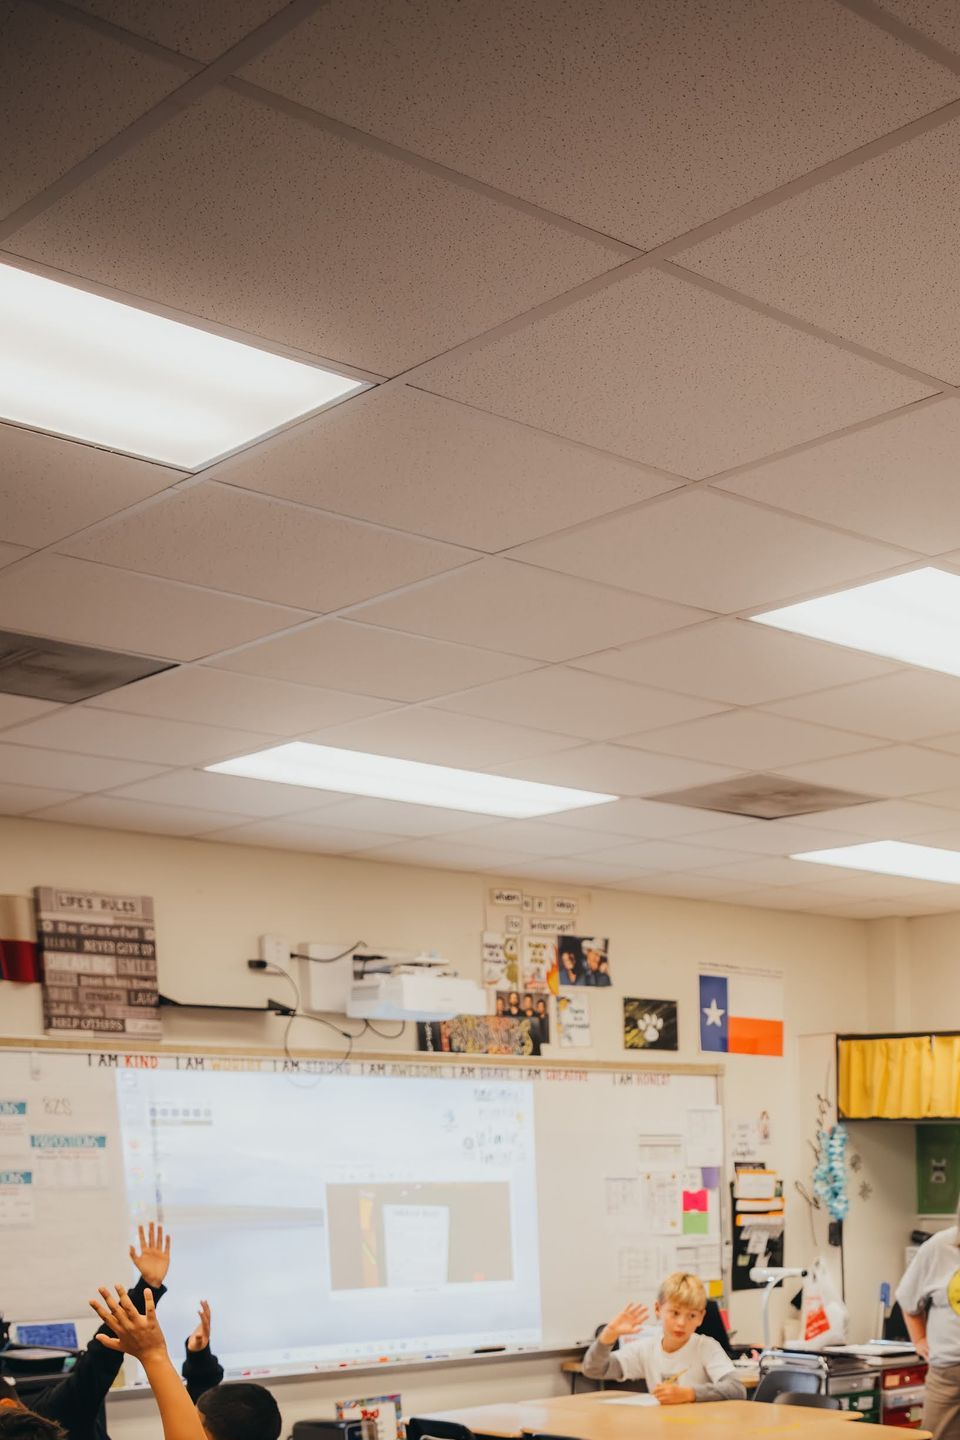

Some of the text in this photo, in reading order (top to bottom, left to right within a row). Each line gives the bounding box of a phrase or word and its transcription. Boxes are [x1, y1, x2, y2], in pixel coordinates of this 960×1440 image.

[60, 896, 136, 912] LIFE'S RULES
[80, 924, 139, 939] Grateful
[83, 940, 116, 953] NEVER
[116, 942, 141, 955] GIVE
[141, 943, 155, 957] UP
[52, 1017, 79, 1029] HELP
[80, 1018, 124, 1030] OTHERS
[98, 1054, 119, 1067] AM
[125, 1055, 158, 1069] KIND
[185, 1057, 205, 1071] AM
[282, 1060, 299, 1073] AM
[369, 1064, 386, 1076] AM
[391, 1064, 446, 1077] AWESOME
[460, 1066, 475, 1079] AM
[527, 1068, 542, 1081] AM
[619, 1073, 633, 1086] AM
